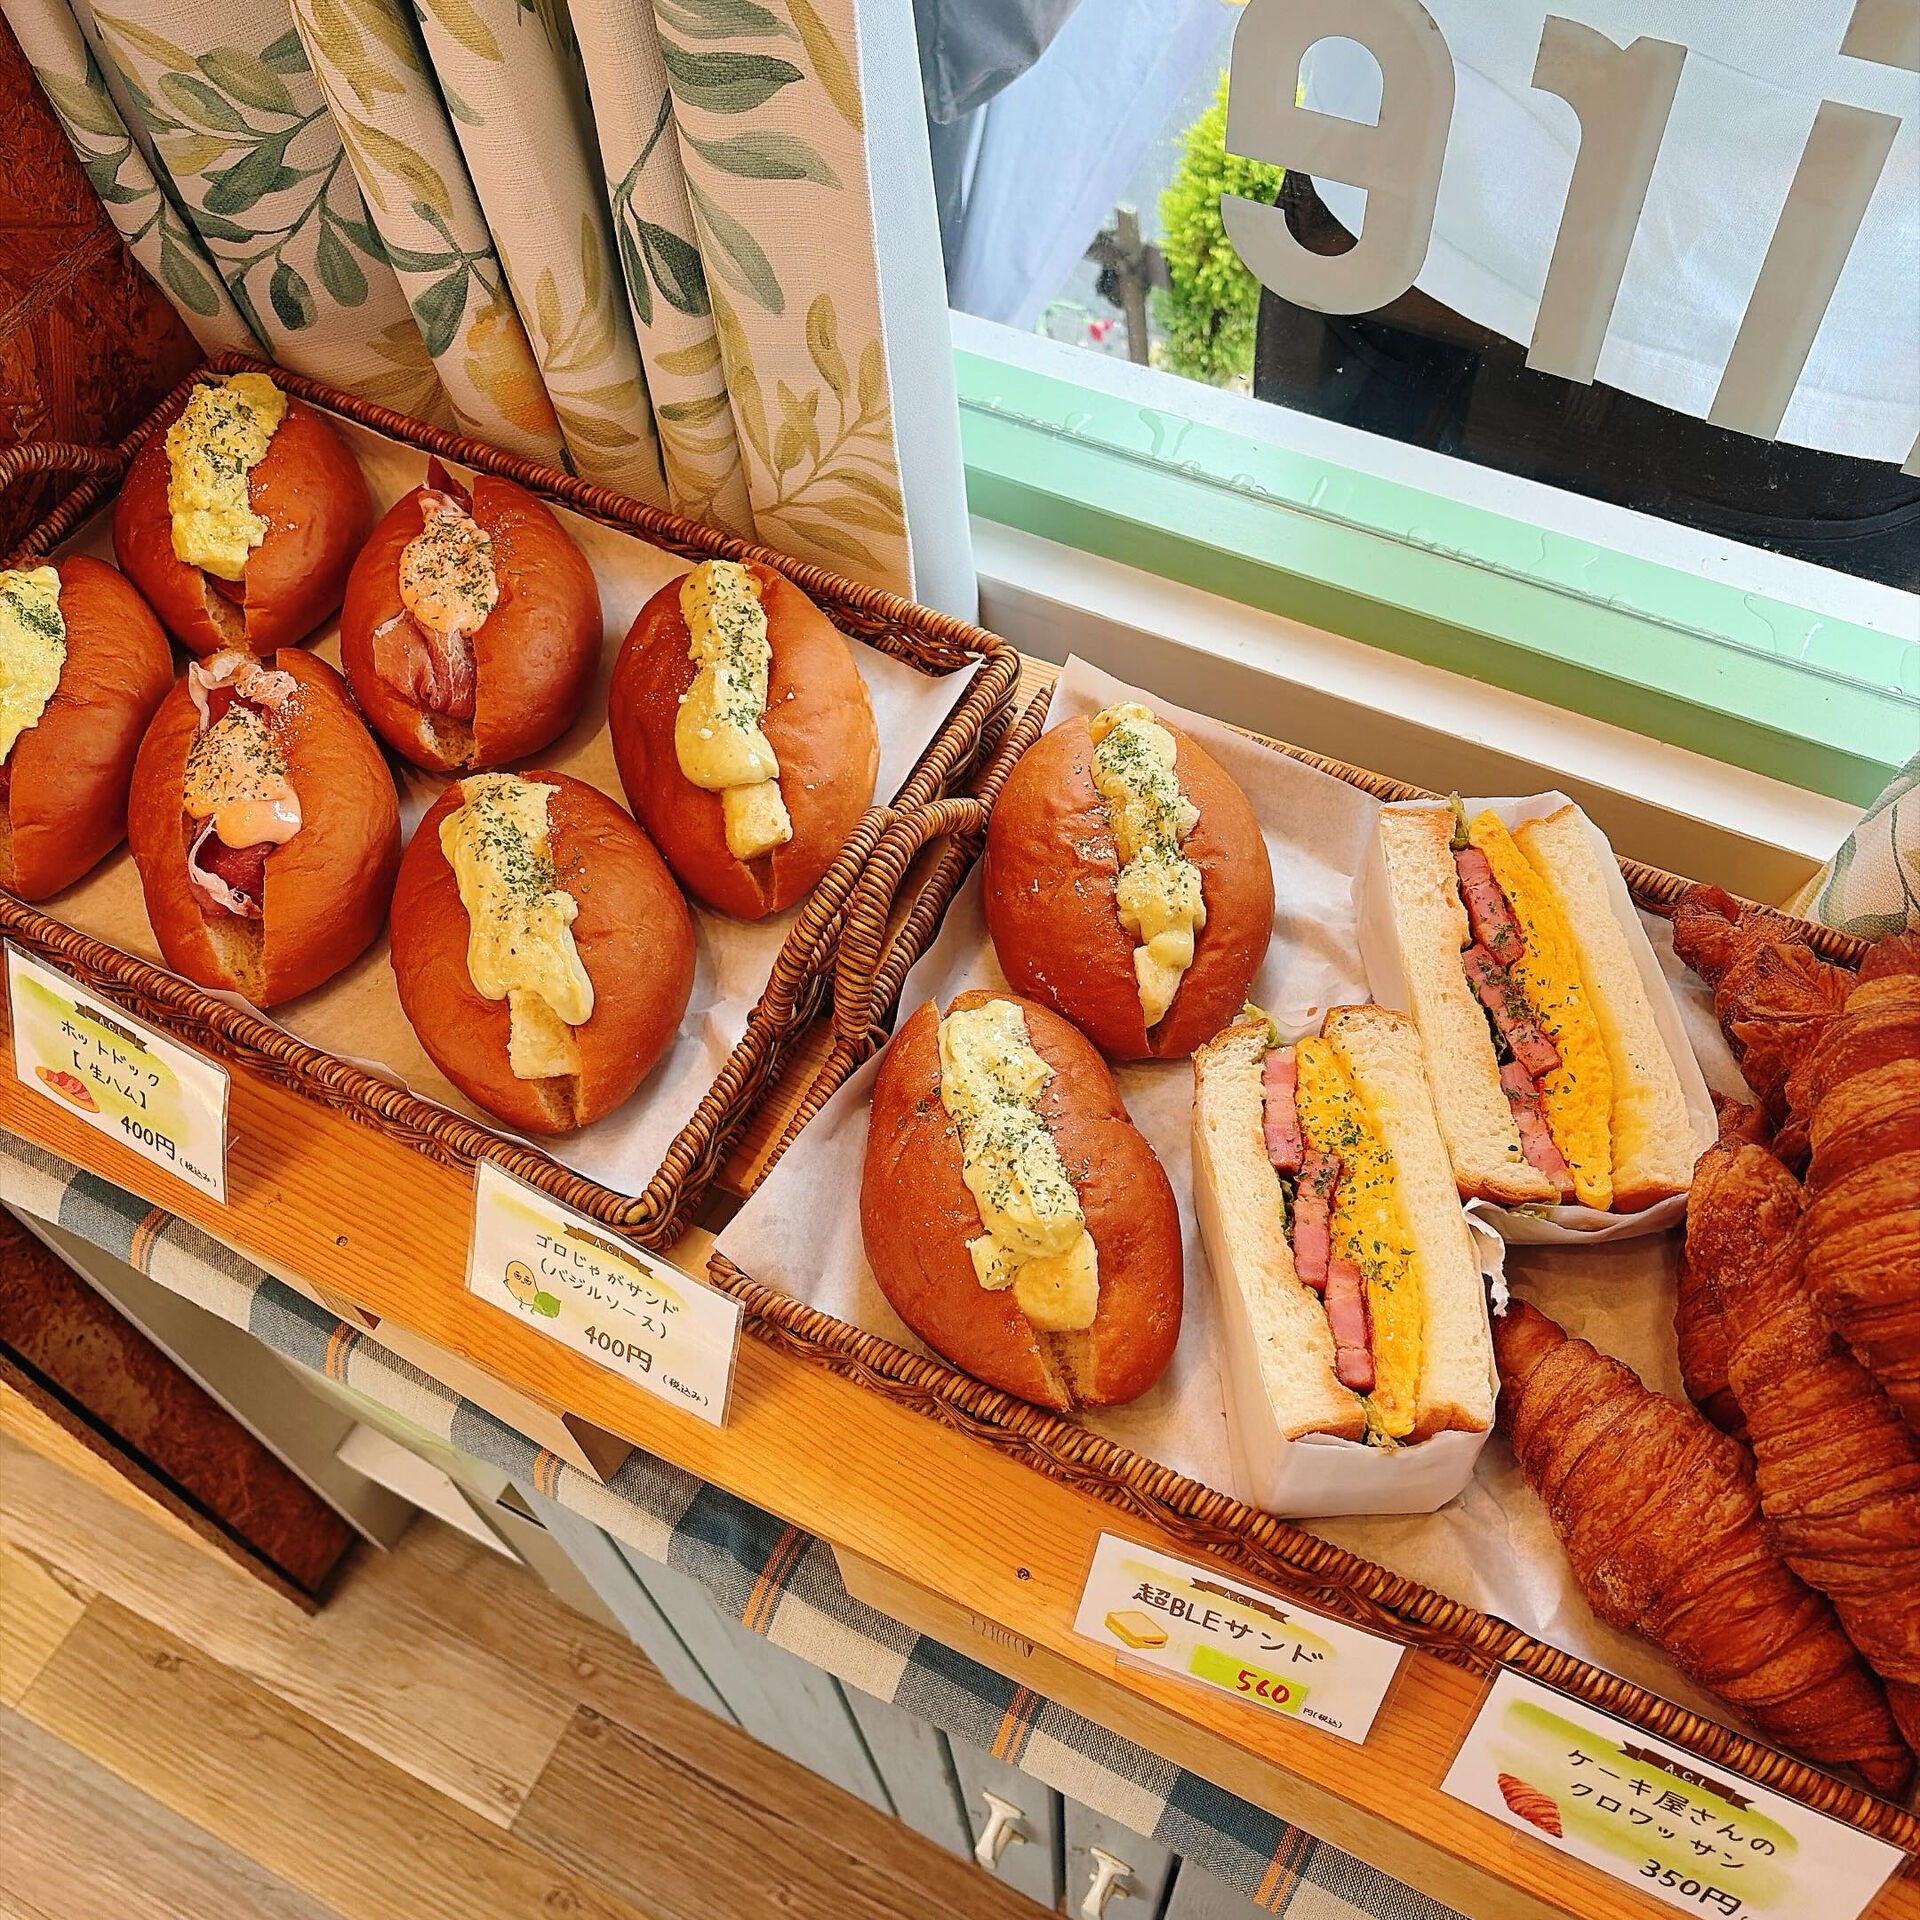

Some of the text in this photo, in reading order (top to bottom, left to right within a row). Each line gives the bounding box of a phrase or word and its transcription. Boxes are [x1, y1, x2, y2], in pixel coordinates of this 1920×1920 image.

[61, 1020, 160, 1087] ホットドック
[73, 1049, 146, 1110] 【生ハム】
[120, 1115, 175, 1161] 400円
[536, 1233, 679, 1315] ゴロじゃがサンド
[540, 1257, 667, 1339] （バジルソース）
[584, 1325, 652, 1373] 400円
[1132, 1582, 1324, 1663] 超BLEサンド
[1236, 1669, 1290, 1704] 560
[1567, 1748, 1776, 1857] ケーキ屋さんの
[1570, 1782, 1746, 1869] クロワッサン
